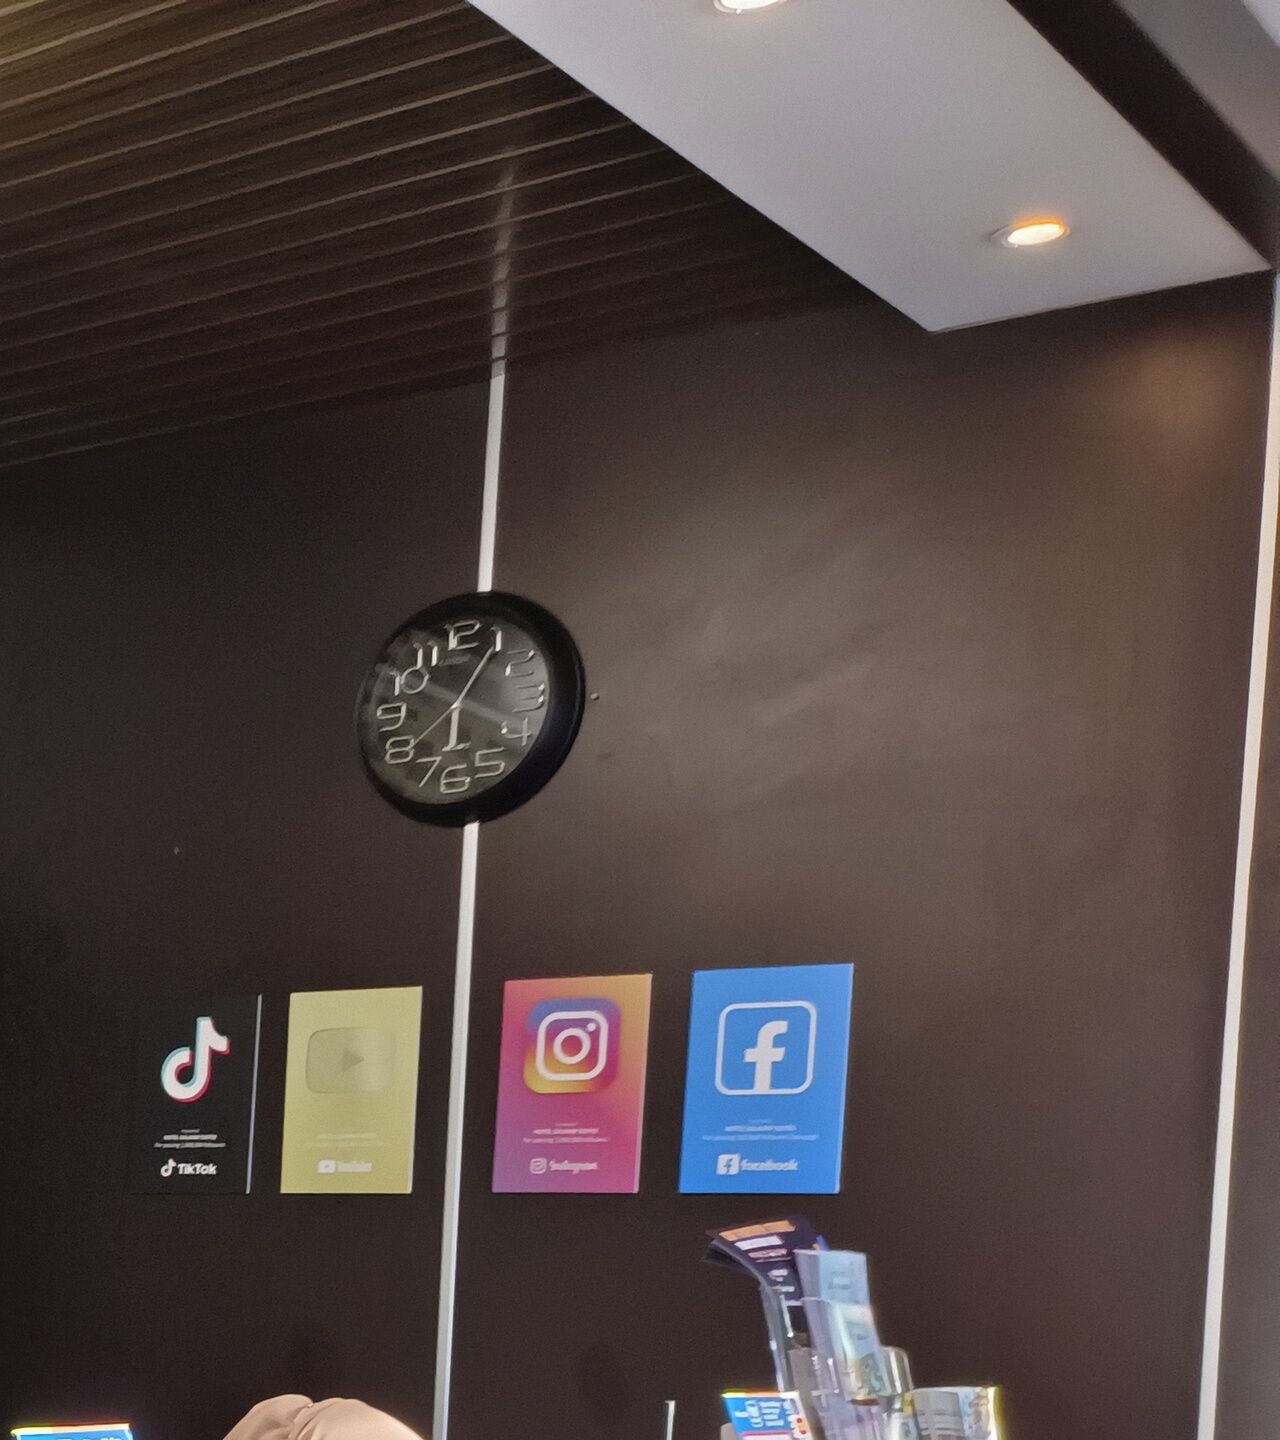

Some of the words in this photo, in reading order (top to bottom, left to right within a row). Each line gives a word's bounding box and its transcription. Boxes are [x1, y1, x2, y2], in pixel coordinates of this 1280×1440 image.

[444, 620, 480, 650] 12
[491, 627, 502, 651] 1
[505, 649, 535, 677] 2
[377, 702, 406, 732] 9
[385, 736, 415, 764] 8
[474, 747, 505, 778] 5
[416, 757, 442, 787] 7
[440, 764, 471, 793] 6
[177, 1163, 217, 1175] TikTok
